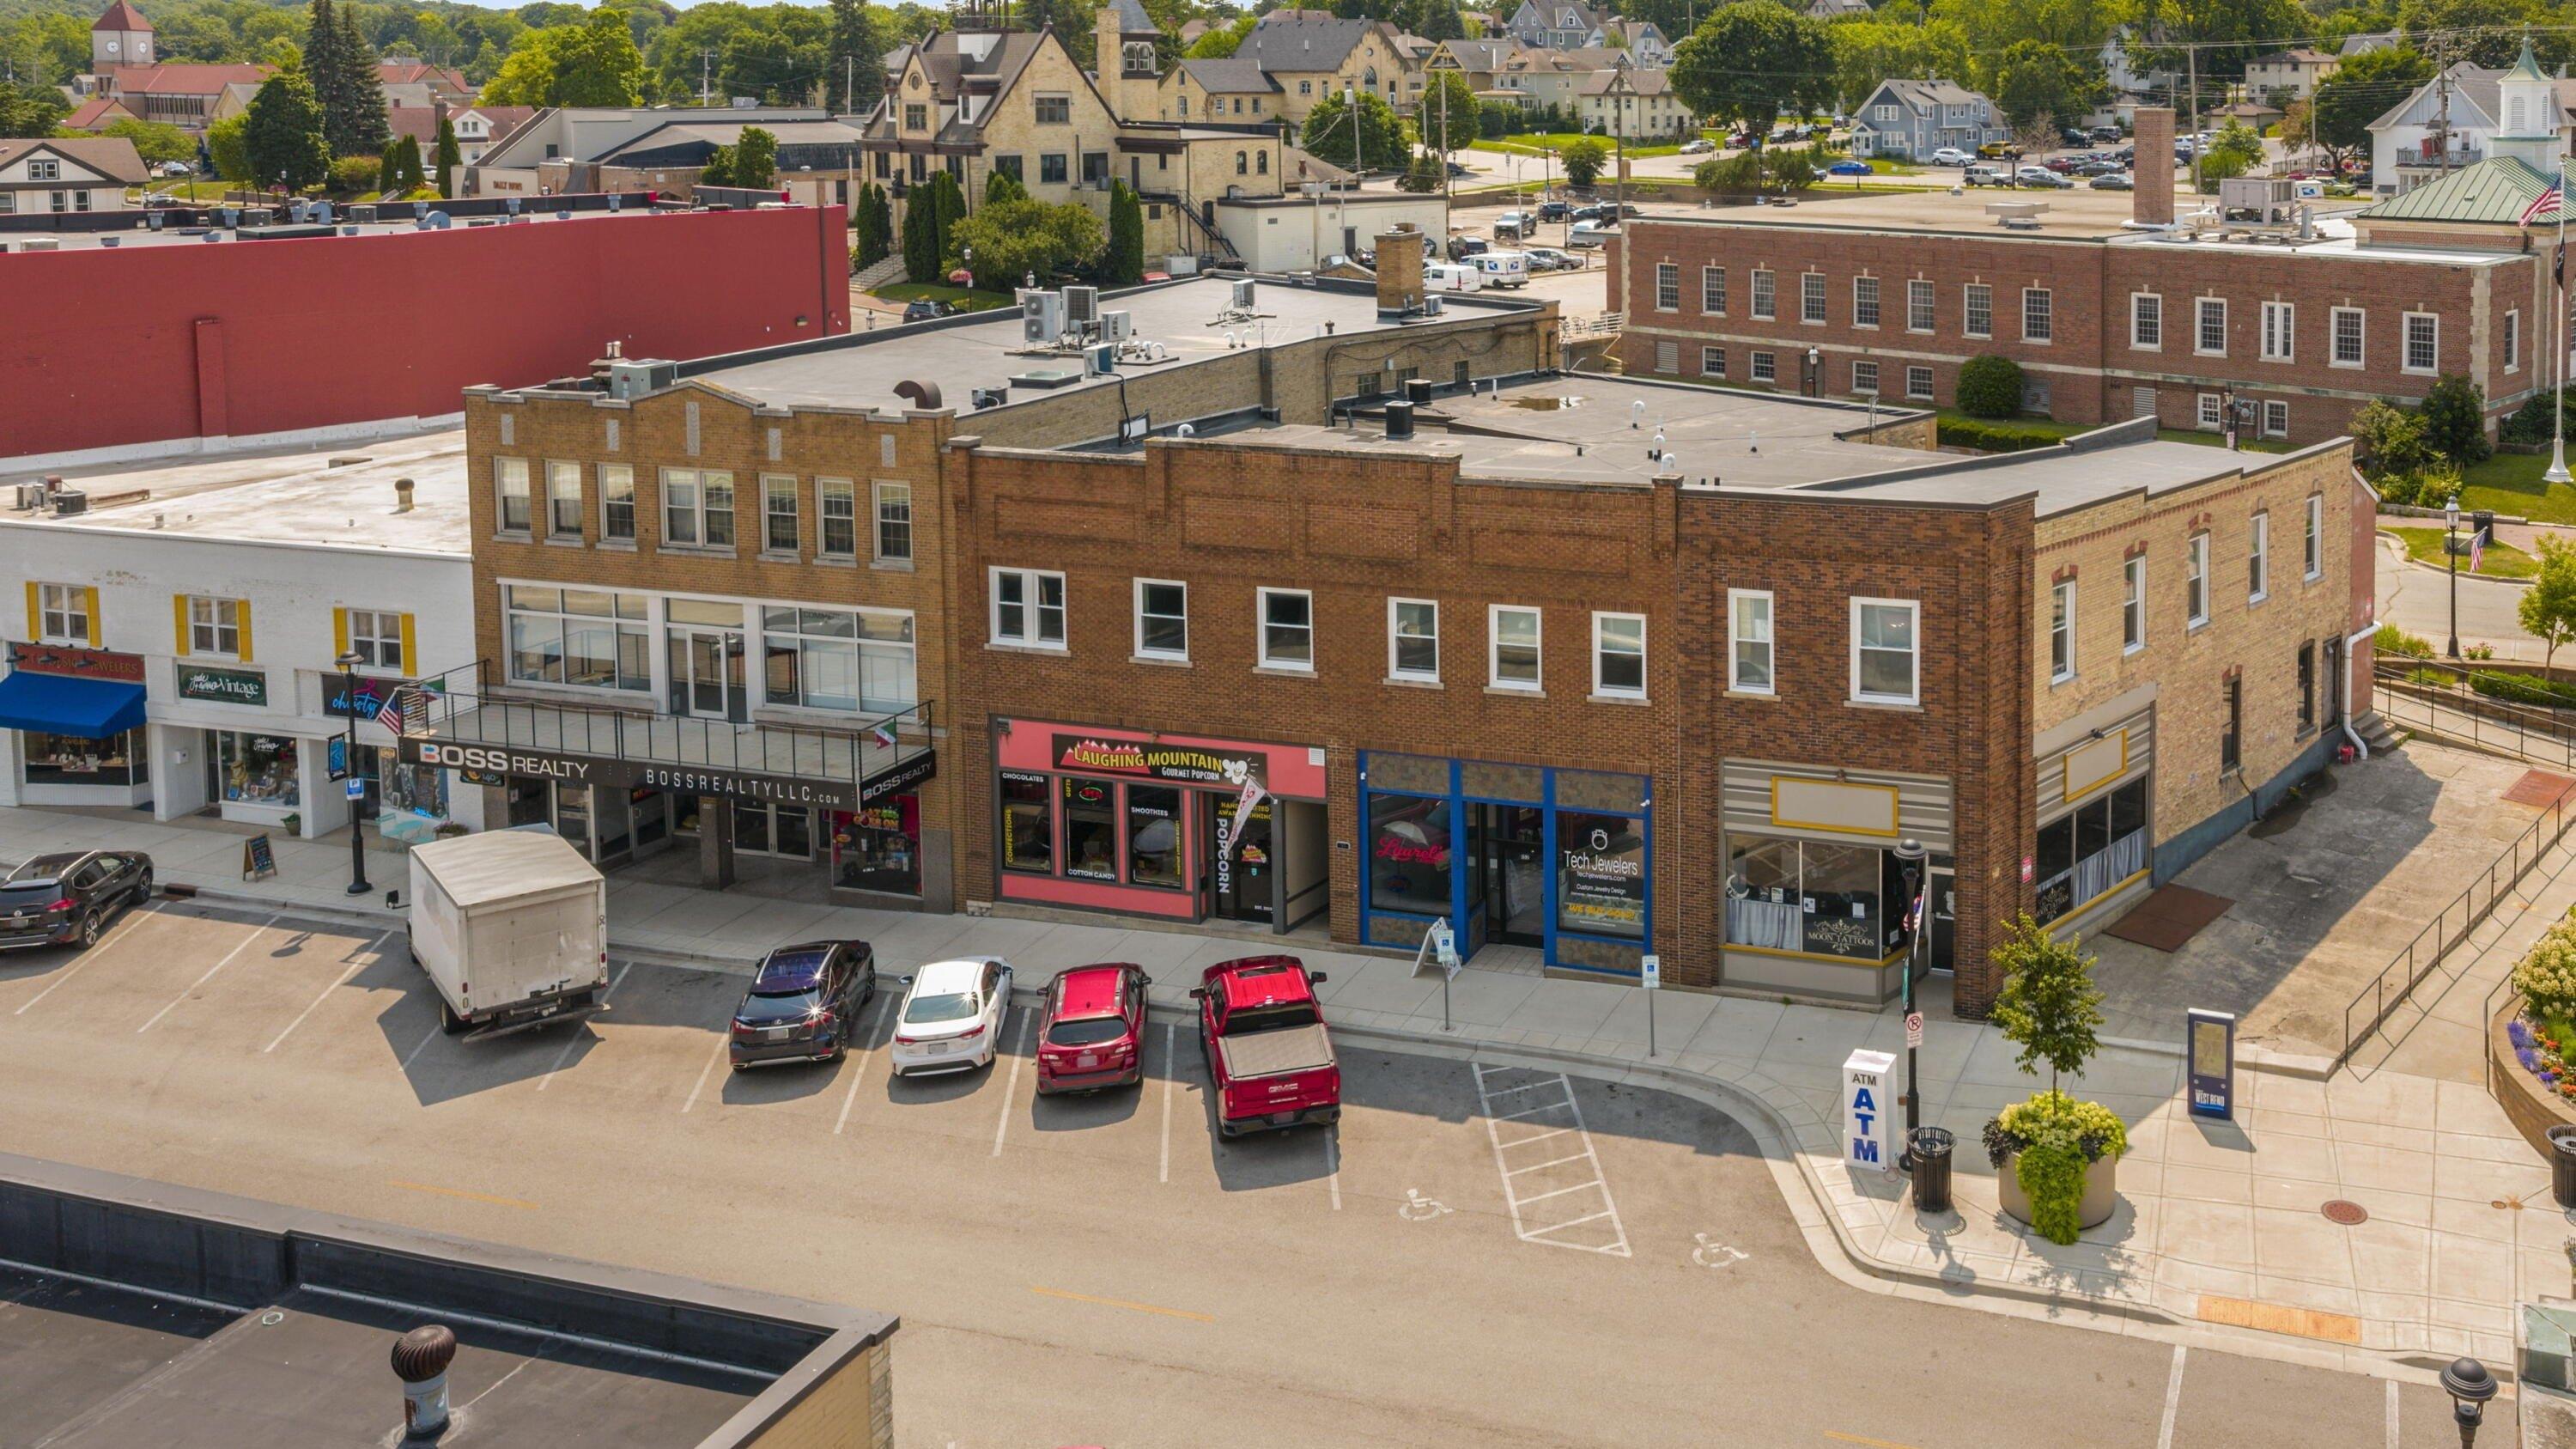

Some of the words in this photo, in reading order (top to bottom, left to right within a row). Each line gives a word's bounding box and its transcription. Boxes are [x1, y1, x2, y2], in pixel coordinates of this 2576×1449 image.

[218, 678, 259, 698] Vintage
[332, 691, 379, 720] chisty
[419, 742, 509, 771] BOSS
[513, 756, 589, 779] REALTY
[1073, 746, 1145, 768] LAUGHING
[1147, 752, 1223, 773] MOUNTAIN
[862, 775, 901, 801] BOSS
[902, 761, 932, 783] REALTY
[1002, 772, 1044, 782] CHOCOLATES
[1161, 766, 1190, 778] GOURMET
[1191, 769, 1219, 781] POPCORN
[1131, 807, 1169, 817] SMOOTHIES
[1217, 818, 1230, 894] POPCORN
[1564, 850, 1590, 870] Tech
[1591, 855, 1638, 876] Jewelers
[1067, 868, 1093, 877] COTTON
[1093, 871, 1115, 880] CANDY
[1576, 883, 1594, 892] Custom
[1610, 887, 1626, 896] Design
[1807, 932, 1833, 941] MOON
[1837, 934, 1874, 947] TATTOOS
[1268, 1083, 1298, 1093] GMC
[1852, 1073, 1877, 1087] ATM
[2195, 1091, 2209, 1105] WEST
[2209, 1093, 2225, 1107] BEND
[1852, 1087, 1879, 1163] ATM
